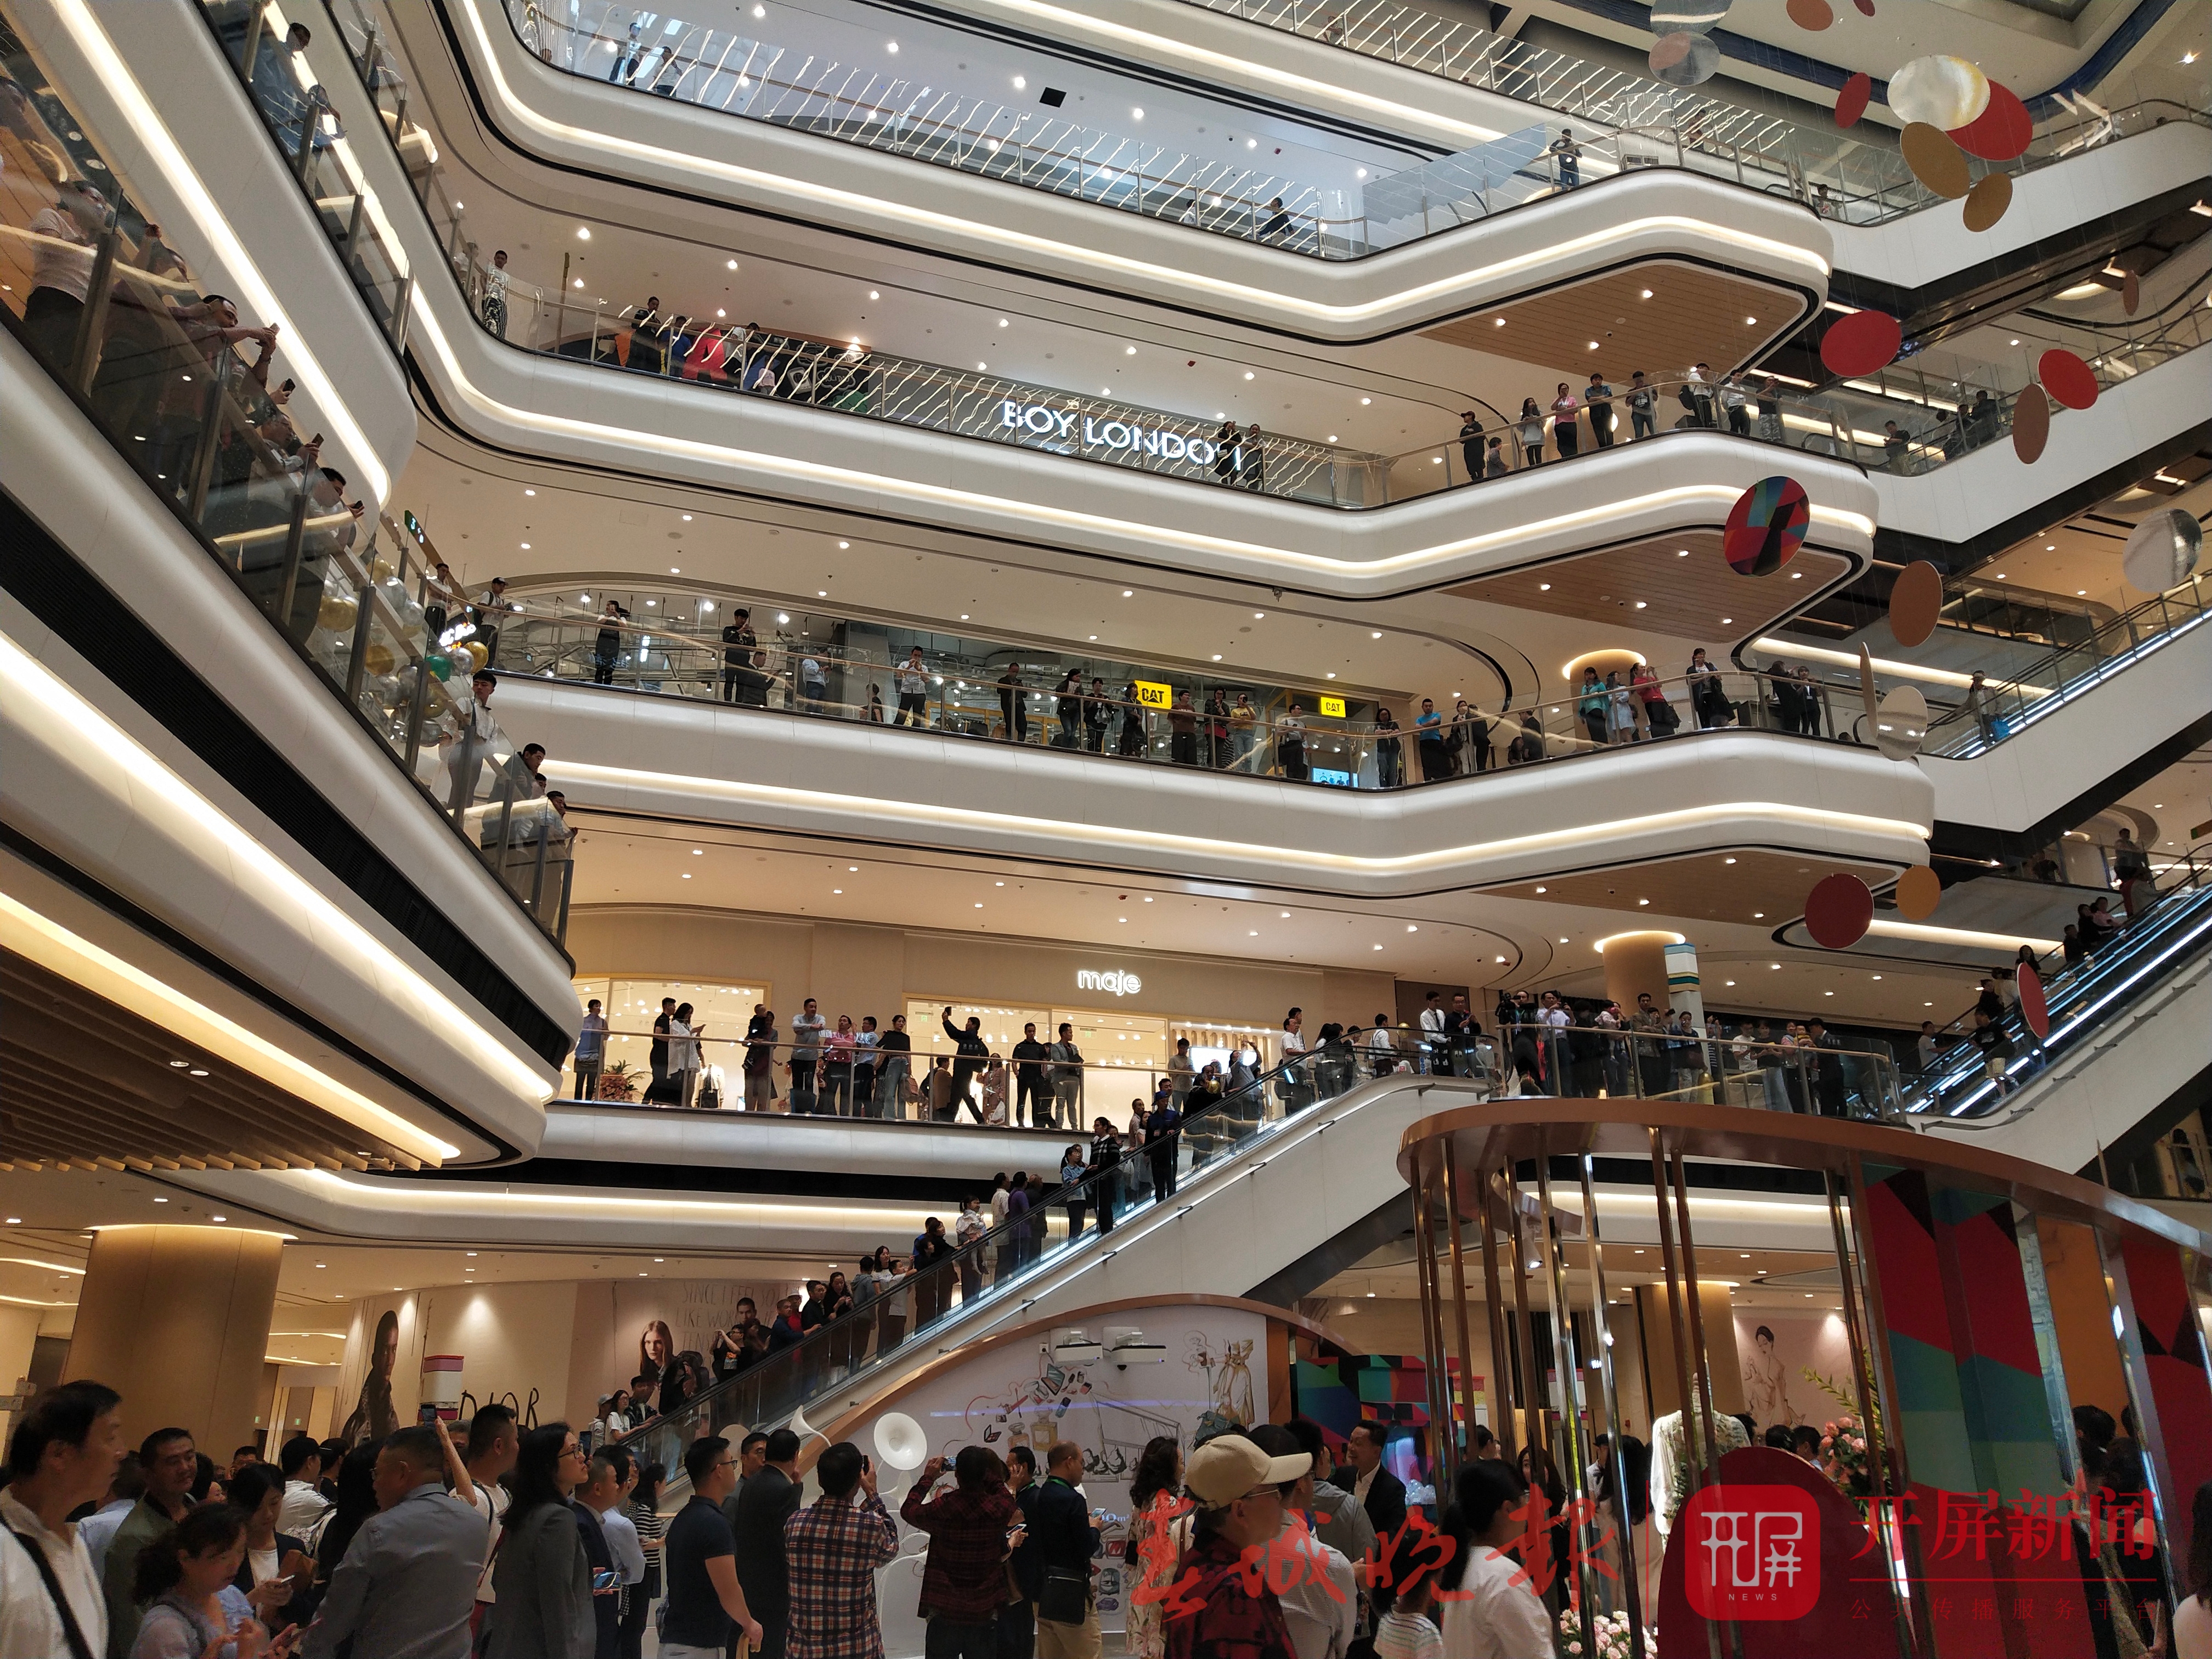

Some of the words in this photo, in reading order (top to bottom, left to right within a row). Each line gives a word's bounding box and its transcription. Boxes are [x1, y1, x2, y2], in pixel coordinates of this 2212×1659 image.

[1003, 400, 1077, 438] BOY
[1142, 688, 1164, 704] CAT
[1326, 702, 1340, 712] CAT
[1078, 970, 1141, 996] maje
